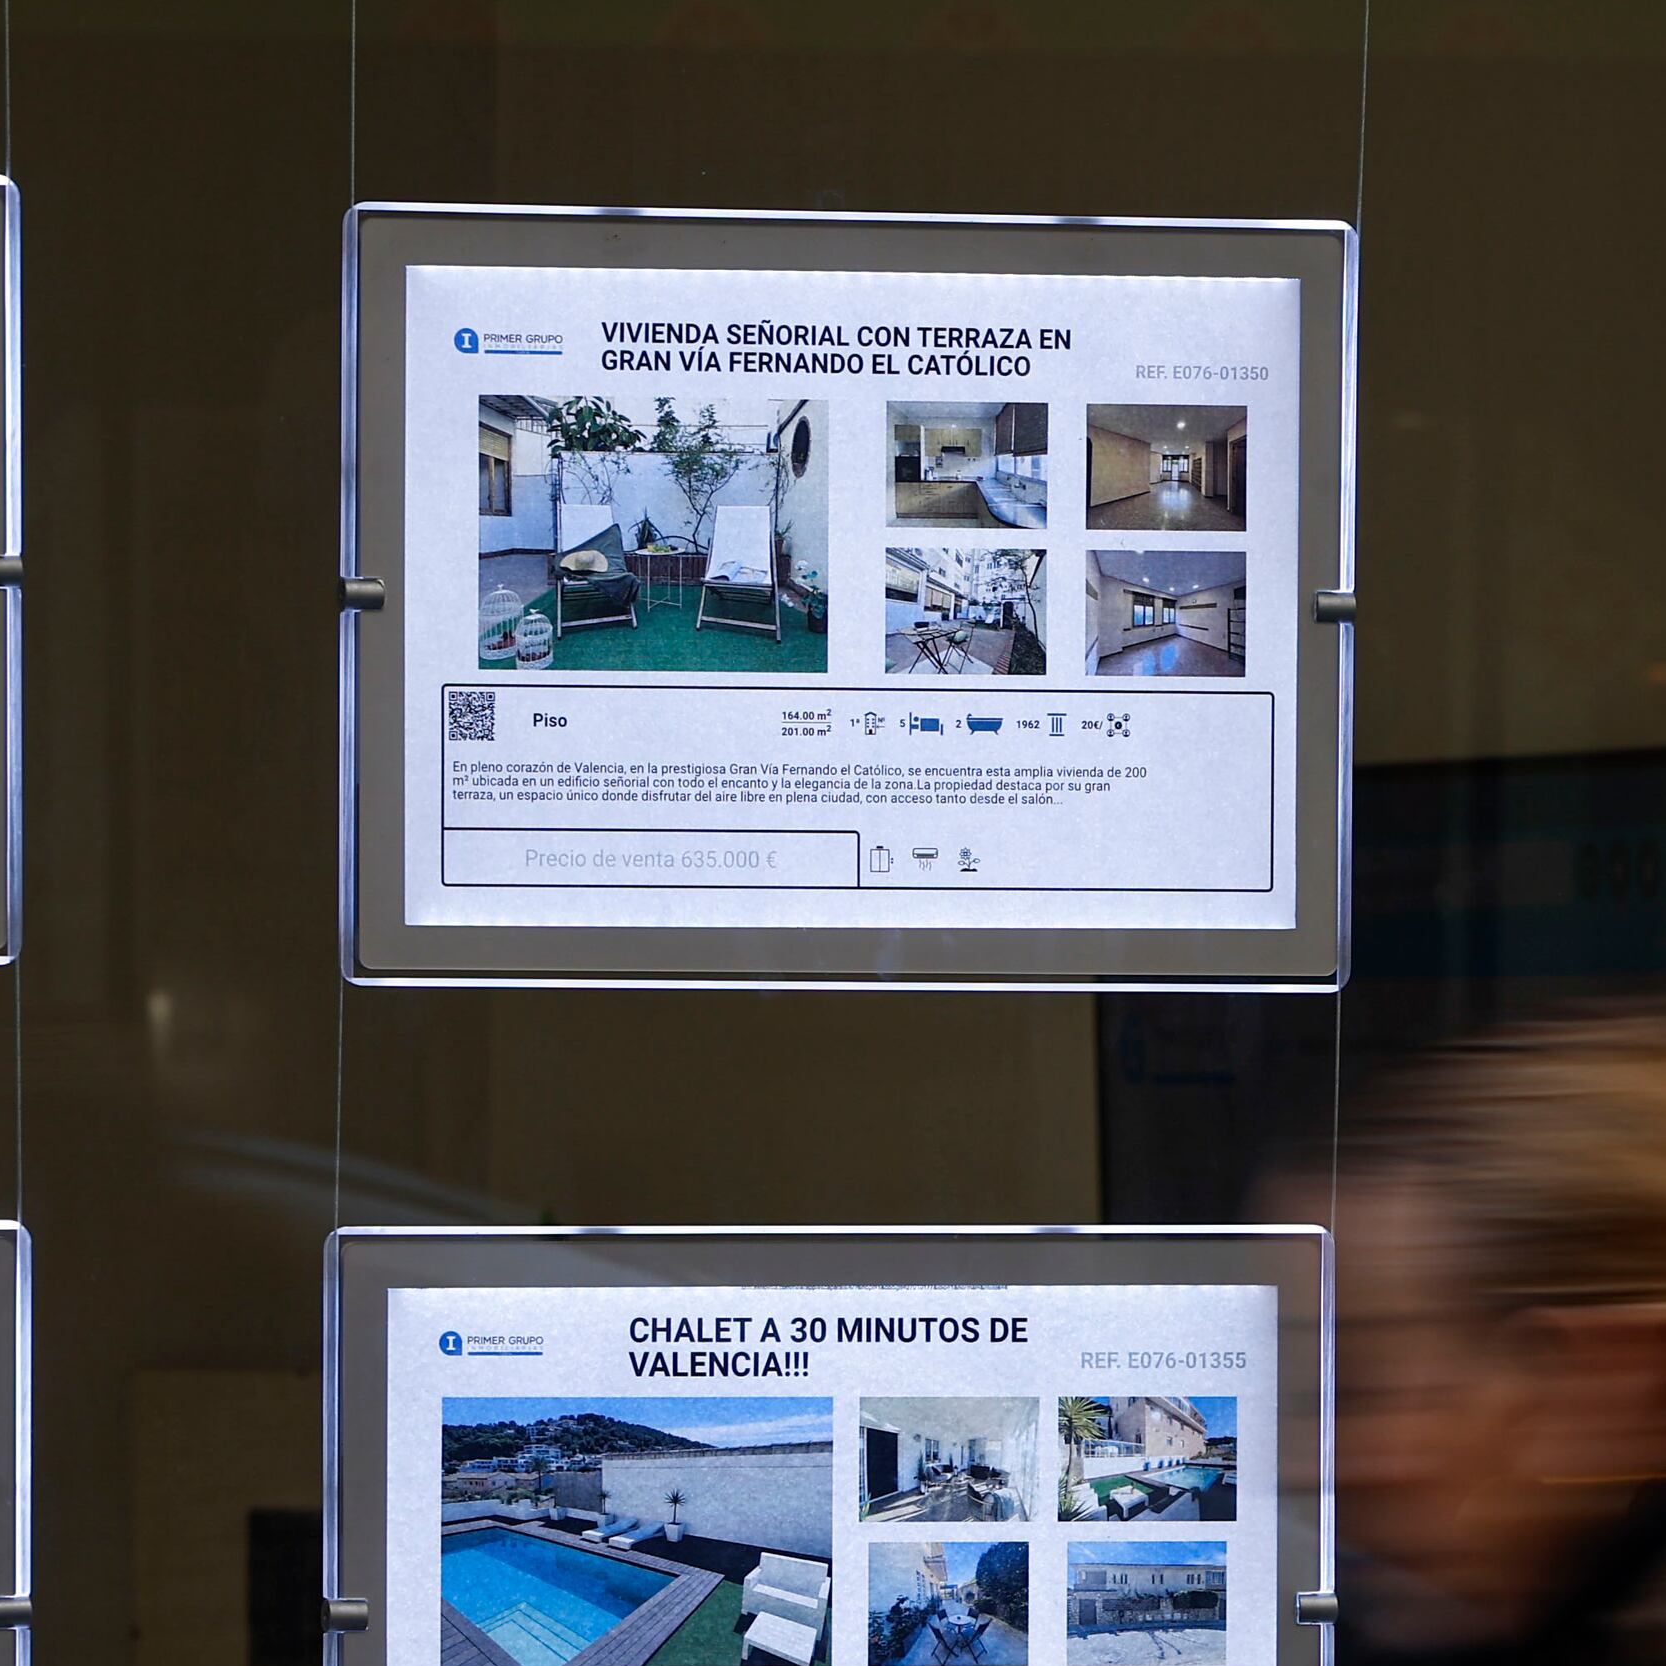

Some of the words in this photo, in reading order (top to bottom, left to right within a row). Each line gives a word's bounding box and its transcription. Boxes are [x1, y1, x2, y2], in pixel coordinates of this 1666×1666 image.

[483, 333, 523, 343] PRIMER
[525, 334, 563, 344] GRUPO
[601, 321, 720, 350] VIVIENDA
[726, 319, 850, 347] SEÑORIAL
[857, 325, 910, 348] CON
[916, 326, 1033, 353] TERRAZA
[1039, 328, 1071, 350] EN
[601, 349, 671, 372] GRAN
[678, 348, 722, 373] VÍA
[729, 351, 864, 375] FERNANDO
[871, 353, 901, 375] EL
[907, 349, 1031, 377] CATÓLICO
[1136, 365, 1170, 379] REF.
[1173, 365, 1269, 381] E076-01350
[533, 712, 568, 728] Piso
[1016, 719, 1040, 729] 1962
[525, 848, 587, 868] Precio
[592, 849, 616, 868] de
[621, 851, 675, 868] venta
[681, 850, 760, 869] 635.000
[766, 850, 777, 869] €
[629, 1316, 753, 1344] CHALET
[759, 1317, 782, 1343] A
[790, 1317, 827, 1343] 30
[837, 1316, 980, 1344] MINUTOS
[990, 1317, 1028, 1343] DE
[467, 1336, 505, 1345] PRIMER
[508, 1336, 544, 1345] GRUPO
[628, 1351, 809, 1377] VALENCIA!!!
[1081, 1352, 1121, 1369] REF.
[1128, 1351, 1247, 1369] E076-01355
